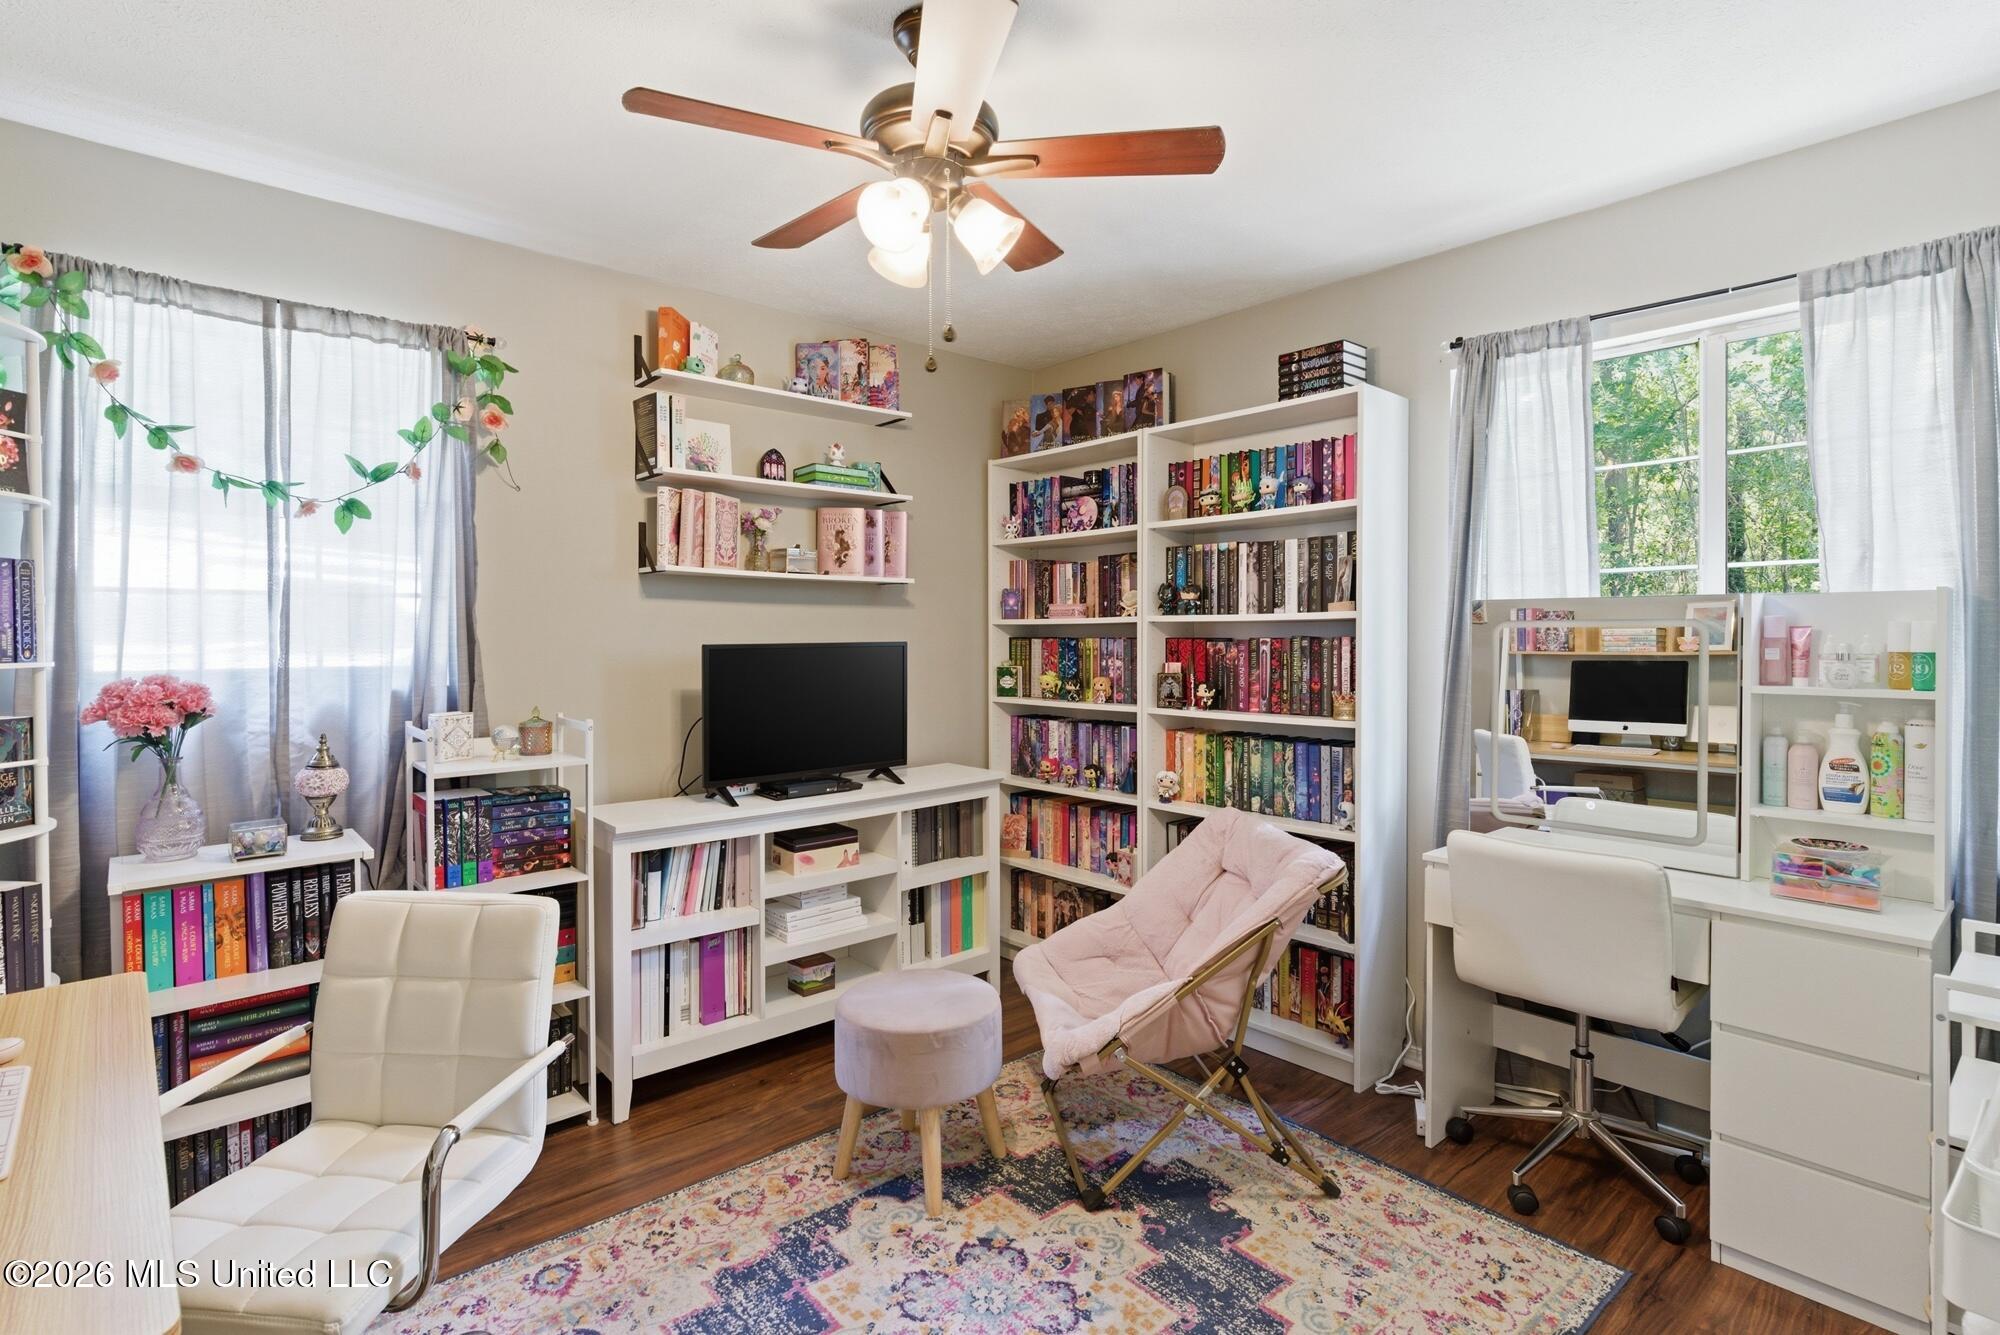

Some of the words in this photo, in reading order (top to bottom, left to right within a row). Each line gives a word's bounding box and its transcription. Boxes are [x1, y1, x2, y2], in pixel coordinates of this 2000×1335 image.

[21, 576, 31, 618] HEAVENLY
[22, 619, 32, 651] BODIES
[303, 877, 320, 919] RECKLESS
[335, 872, 352, 899] FEAR
[271, 881, 289, 932] POWERLESS
[239, 1013, 257, 1023] HEIR
[226, 1033, 253, 1045] EMPIRE
